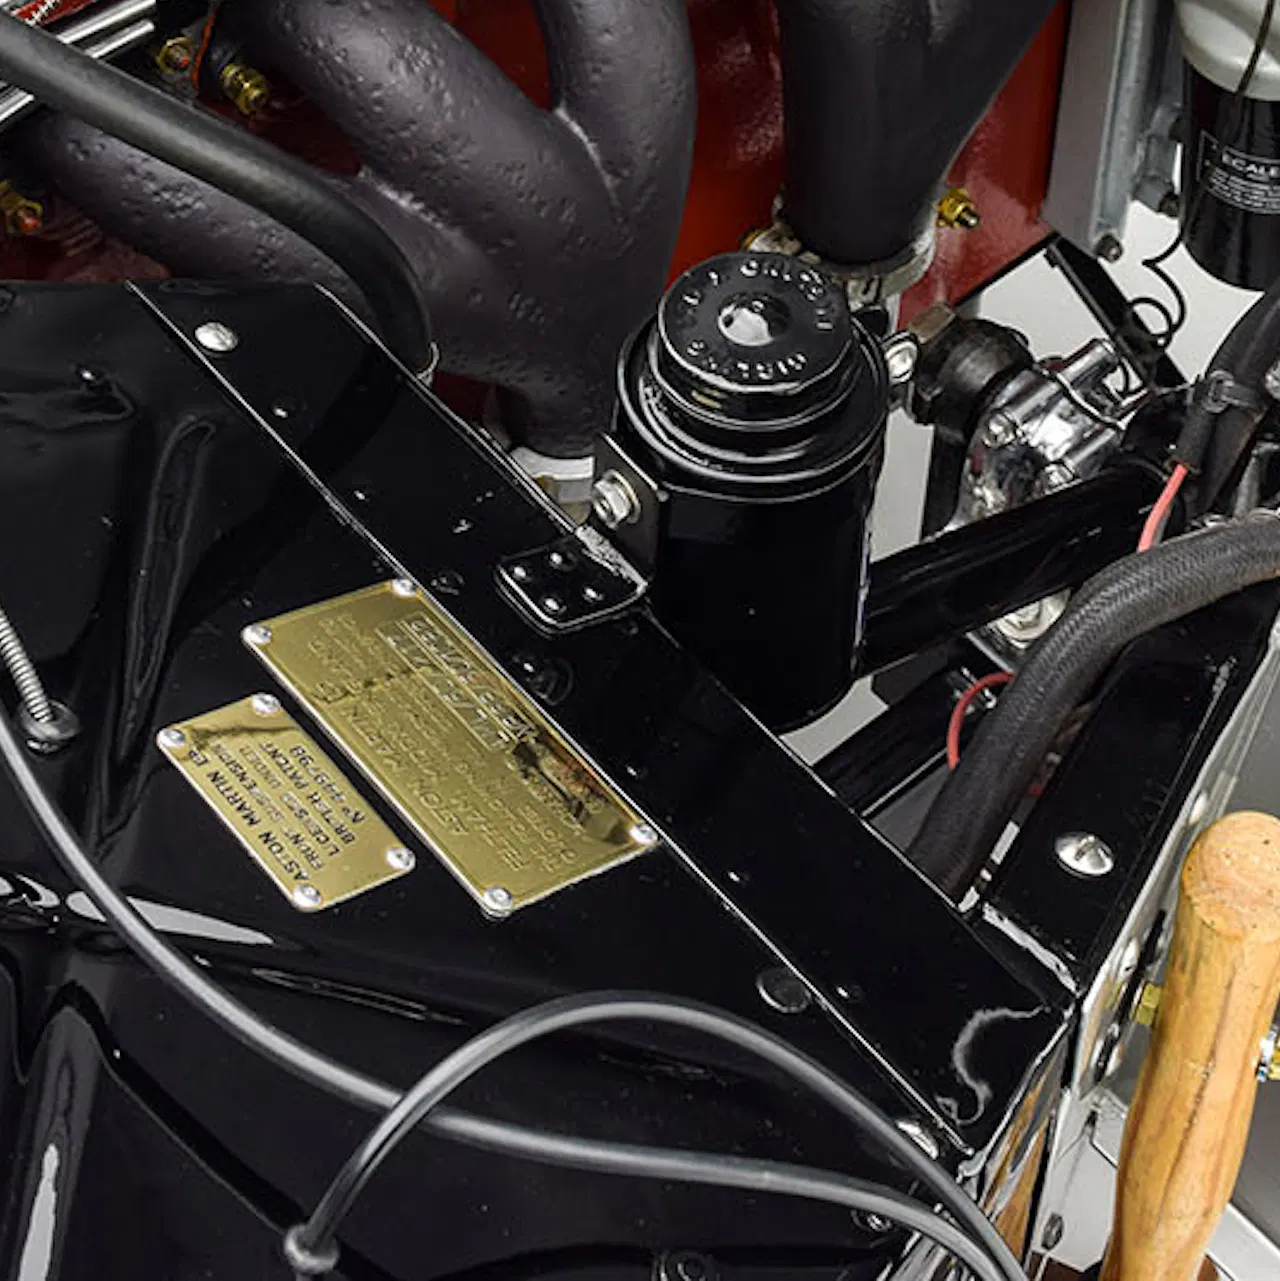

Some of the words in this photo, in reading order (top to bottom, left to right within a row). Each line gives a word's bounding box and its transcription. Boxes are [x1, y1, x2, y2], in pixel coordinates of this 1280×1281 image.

[260, 740, 308, 788] PATENT
[205, 771, 260, 825] MARTIN
[306, 793, 355, 842] BRITISH
[257, 831, 308, 881] ASTON
[284, 829, 325, 868] FRONT
